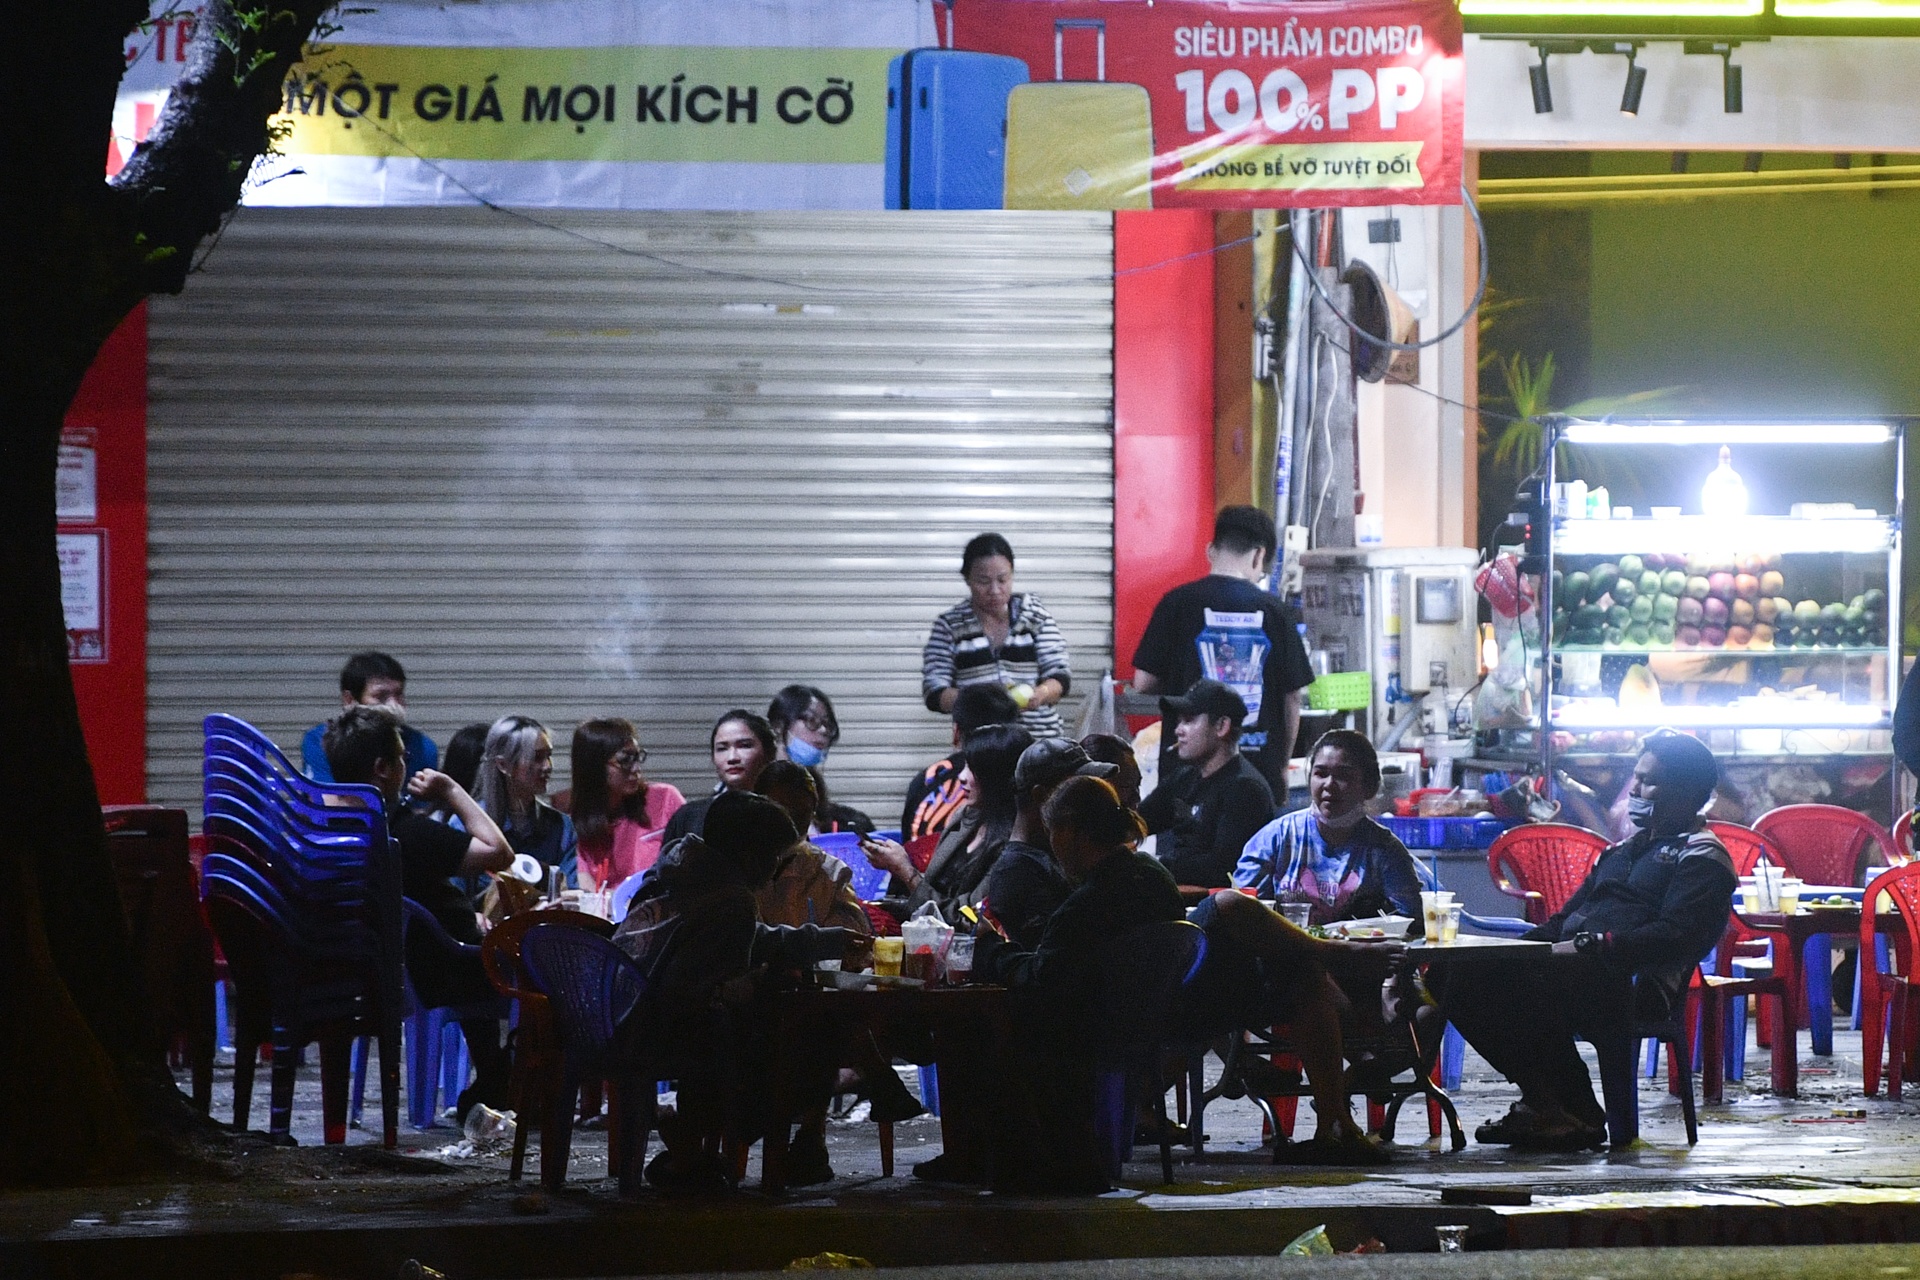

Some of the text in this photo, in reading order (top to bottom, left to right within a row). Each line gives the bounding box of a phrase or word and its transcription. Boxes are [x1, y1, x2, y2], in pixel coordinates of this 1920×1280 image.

[1174, 17, 1424, 58] SIÊU PHẨM COMBO
[285, 70, 854, 134] MỘT GIÁ MỌI KÍCH CỠ
[1329, 66, 1425, 131] PP
[1289, 156, 1317, 175] VỠ
[1323, 156, 1371, 179] TUYỆT
[1376, 153, 1411, 174] ĐỐI
